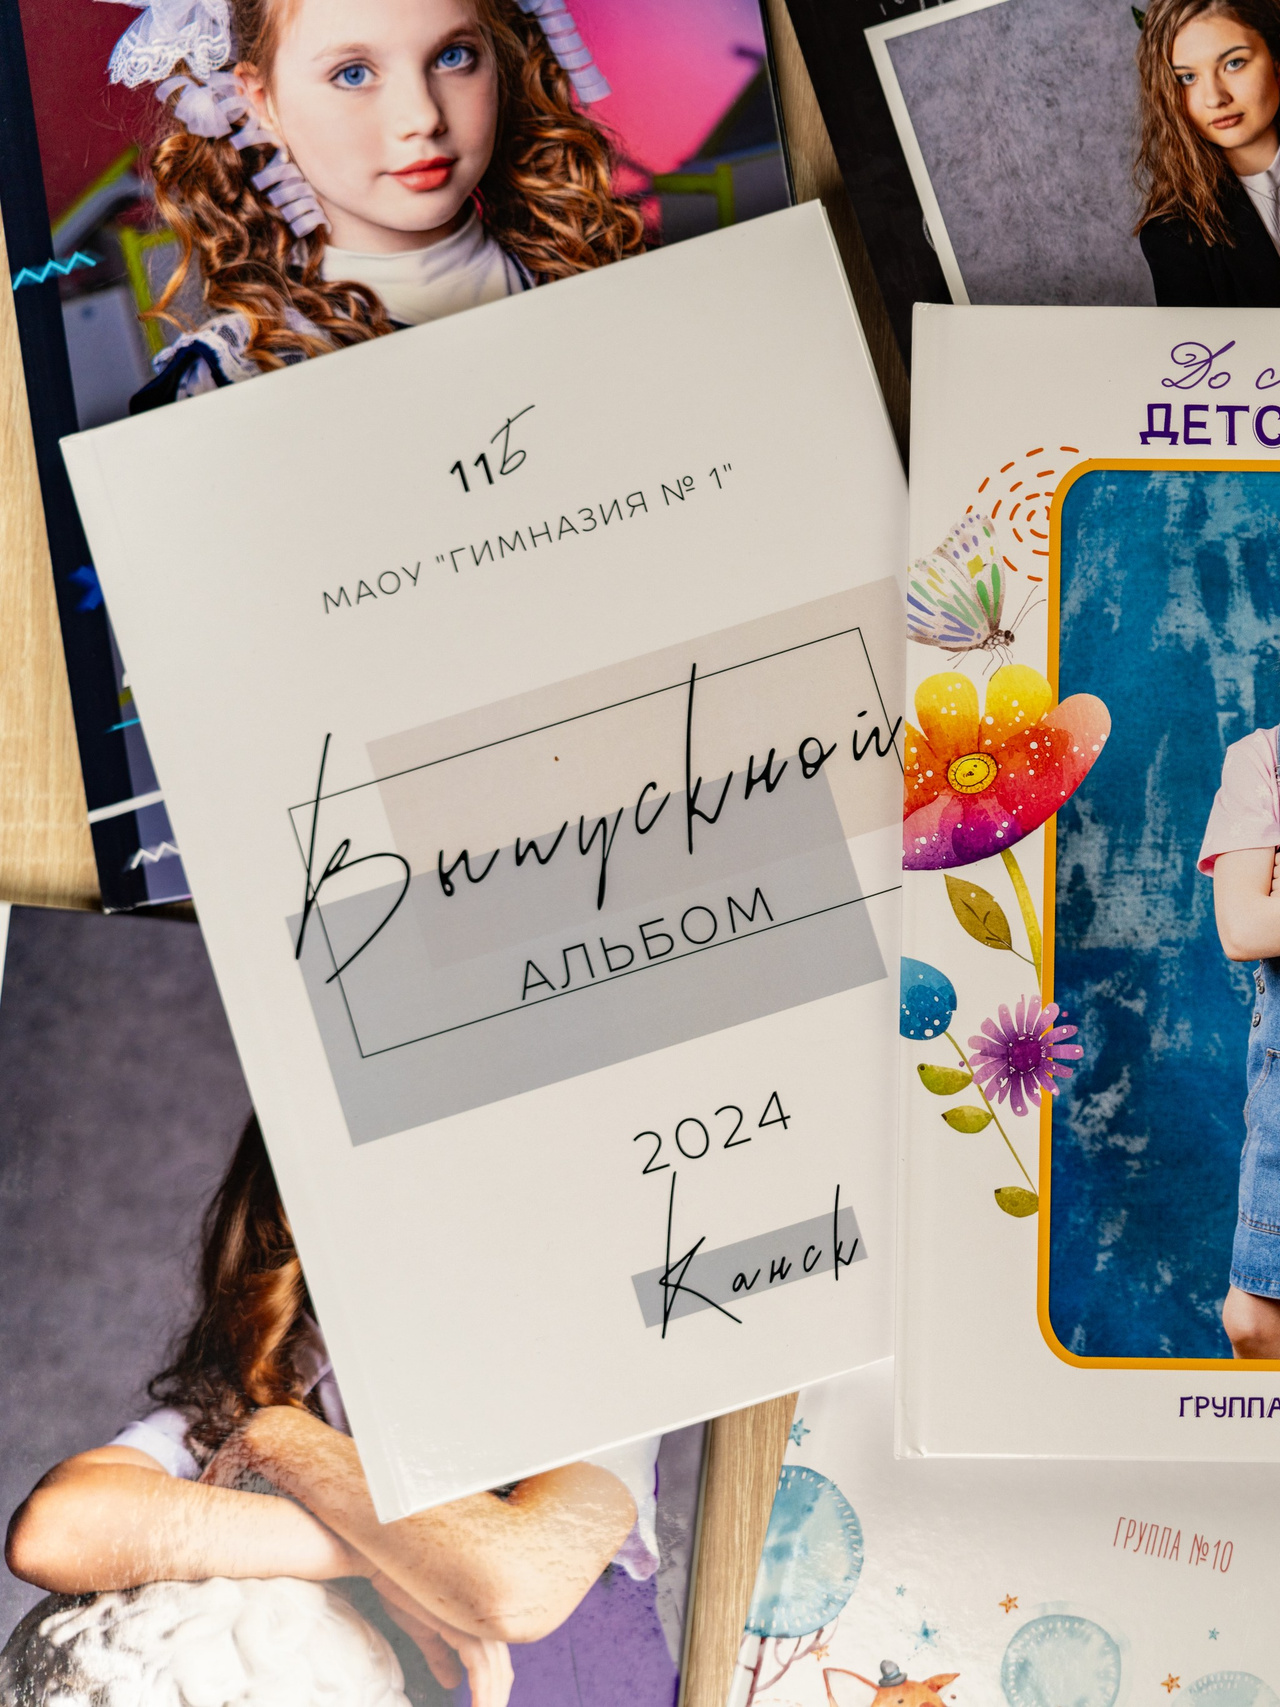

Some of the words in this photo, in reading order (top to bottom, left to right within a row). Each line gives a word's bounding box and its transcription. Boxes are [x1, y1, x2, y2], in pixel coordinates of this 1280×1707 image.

[1161, 340, 1236, 390] До
[323, 561, 421, 614] МАОУ
[435, 491, 649, 573] "ГИМНАЗИЯ
[660, 475, 696, 506] №
[708, 463, 733, 489] 1"
[296, 662, 903, 984] Выпускной
[522, 887, 775, 1000] АЛЬБОМ
[633, 1091, 791, 1174] 2024
[658, 1170, 859, 1340] Канск
[1113, 1516, 1182, 1562] ГРУППА
